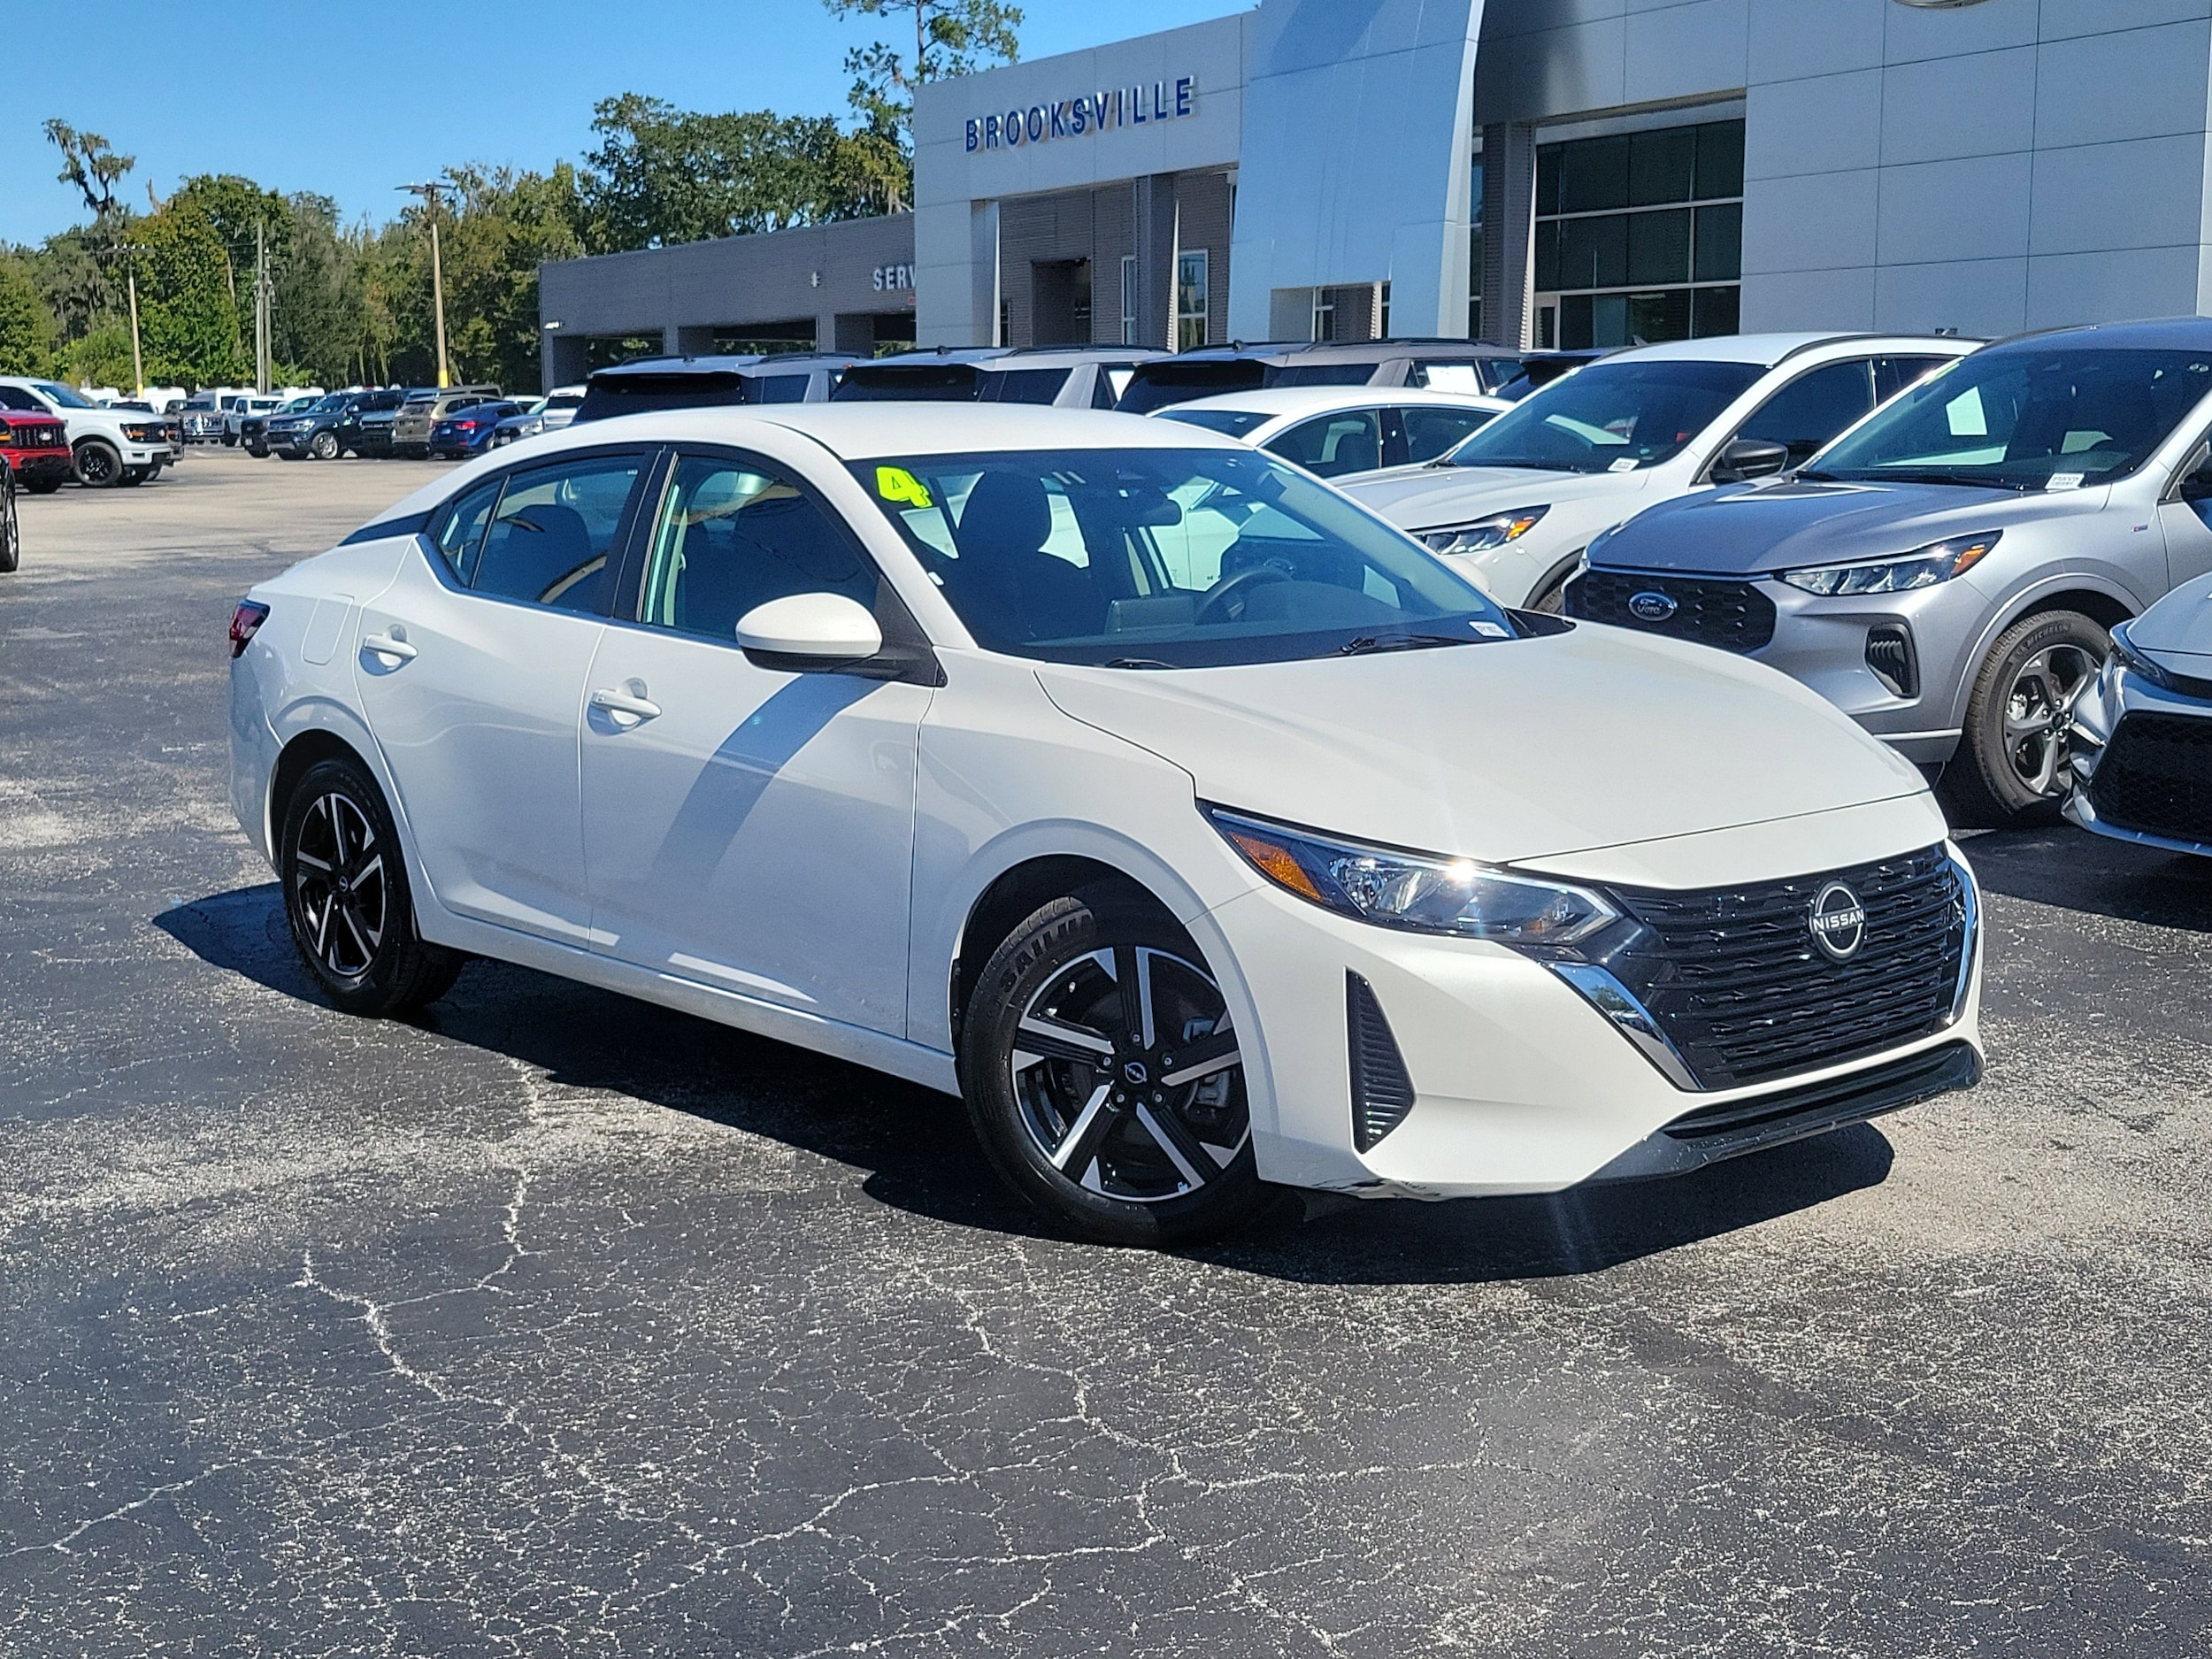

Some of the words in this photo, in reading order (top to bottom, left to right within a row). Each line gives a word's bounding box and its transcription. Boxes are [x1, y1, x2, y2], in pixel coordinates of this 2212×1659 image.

[965, 76, 1194, 152] BROOKSVILLE
[876, 466, 933, 508] 4
[1812, 909, 1865, 931] NISSAN
